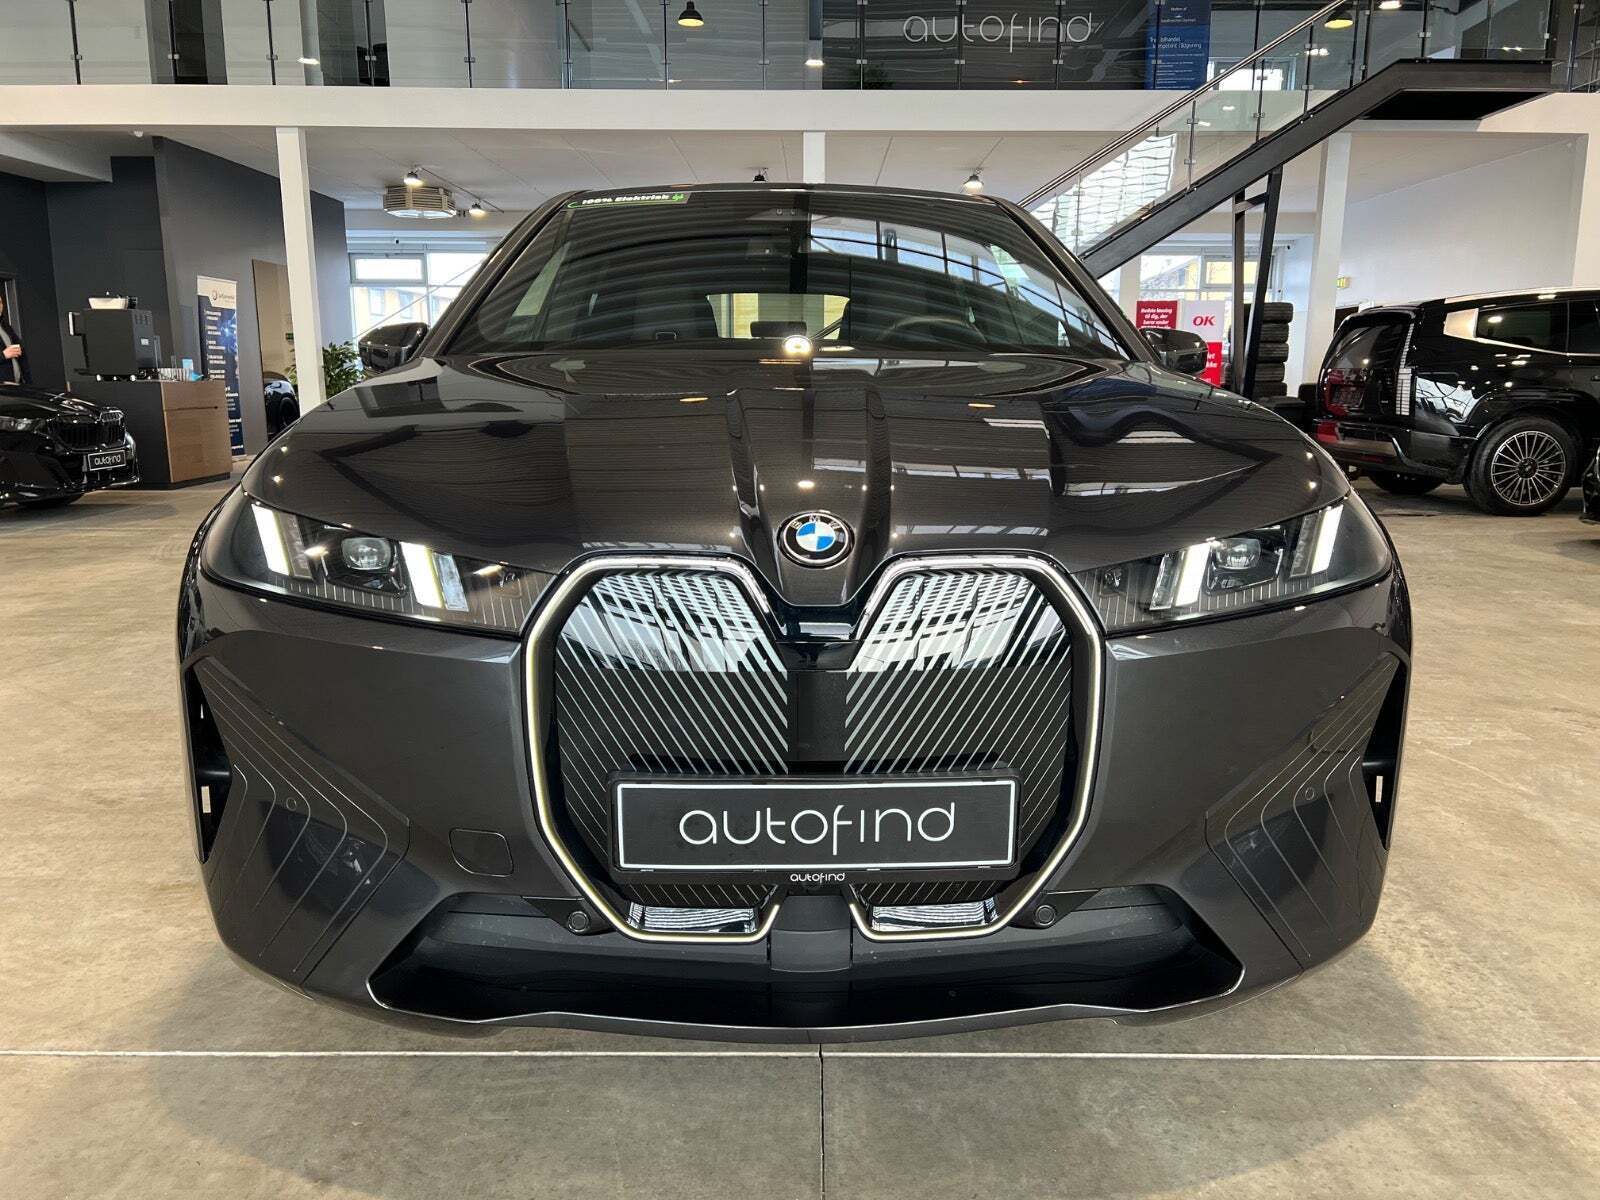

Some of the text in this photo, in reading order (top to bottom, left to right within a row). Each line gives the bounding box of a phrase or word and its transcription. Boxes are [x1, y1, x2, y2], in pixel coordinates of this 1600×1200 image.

[903, 12, 1092, 53] autofind
[1193, 315, 1216, 326] OK
[679, 802, 955, 856] autofind
[790, 872, 846, 884] autofind
